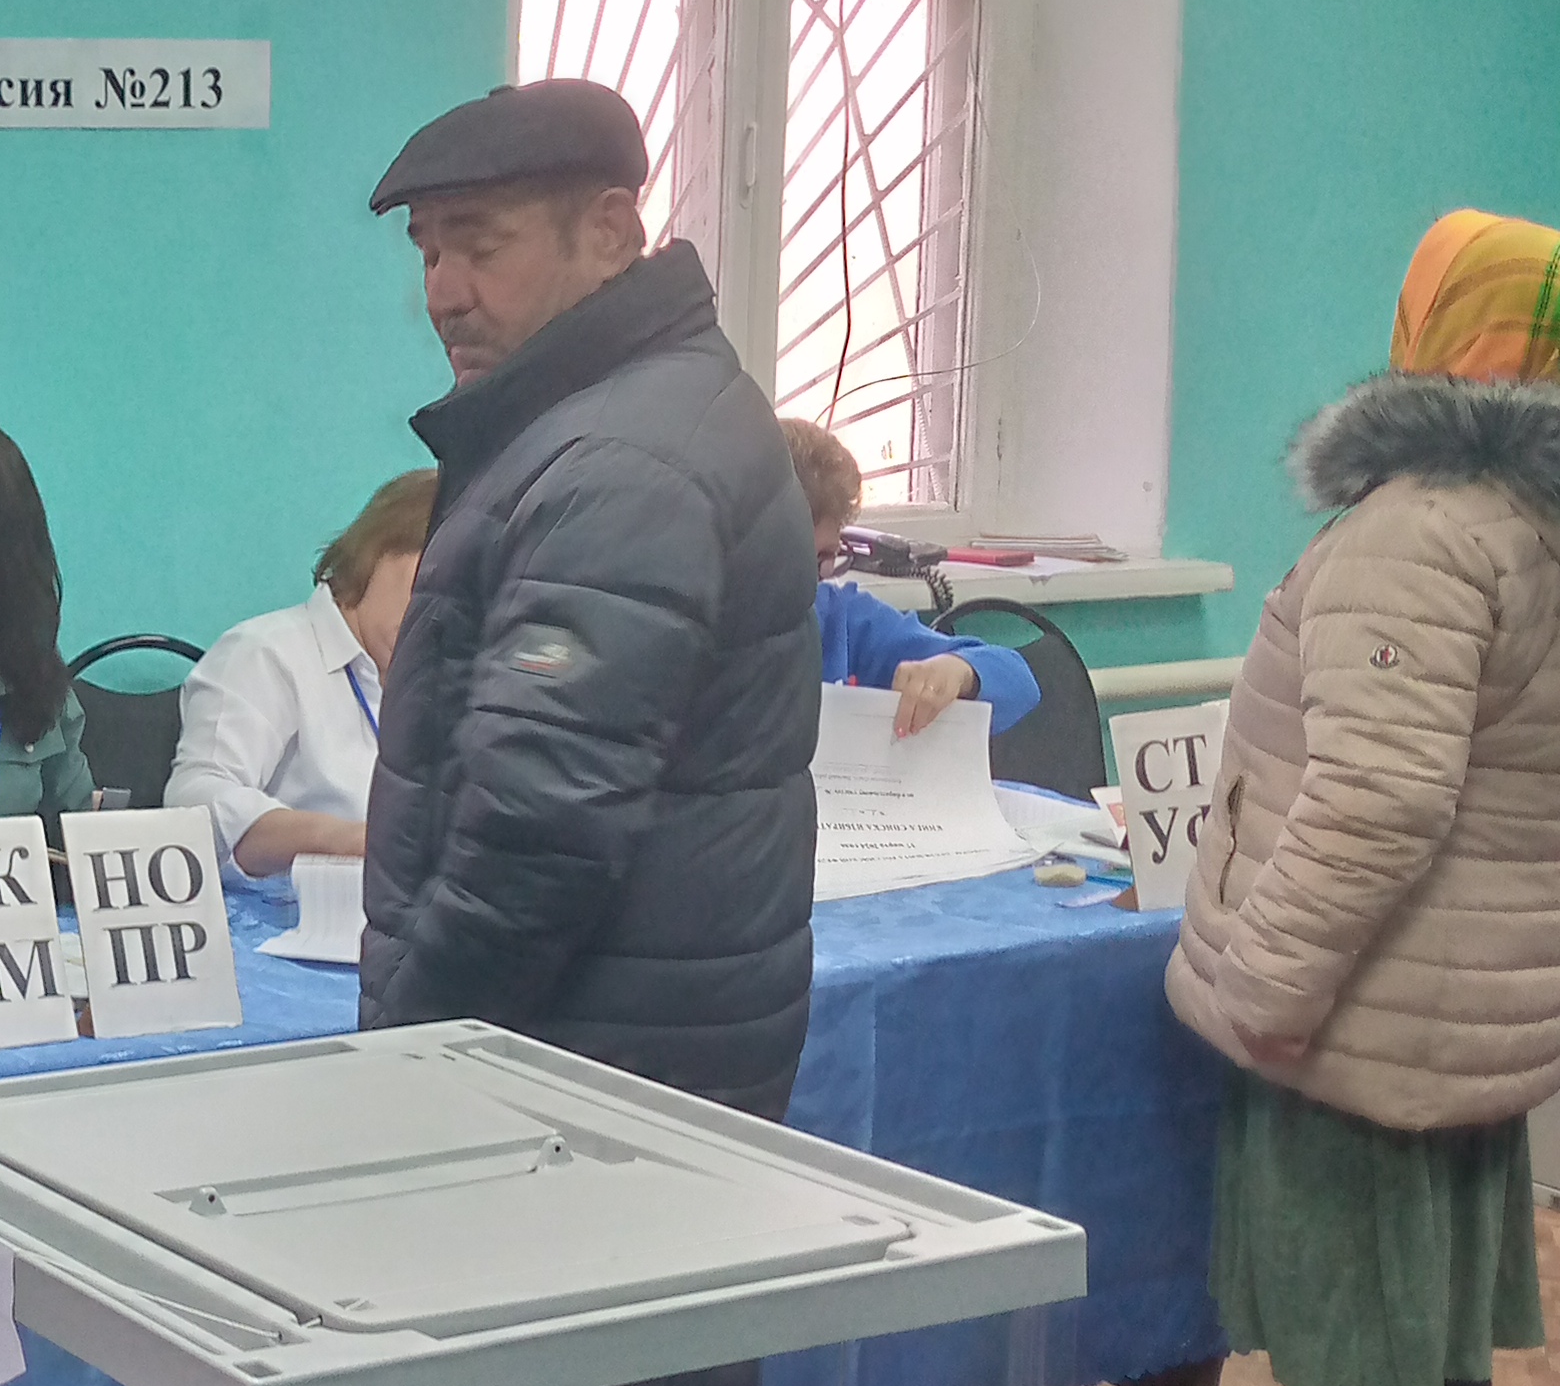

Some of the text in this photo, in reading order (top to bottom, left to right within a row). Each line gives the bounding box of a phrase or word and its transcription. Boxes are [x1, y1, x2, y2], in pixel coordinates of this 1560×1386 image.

[95, 66, 224, 112] №213
[1135, 734, 1208, 794] СТ
[84, 844, 204, 911] НО
[102, 920, 208, 987] ПР
